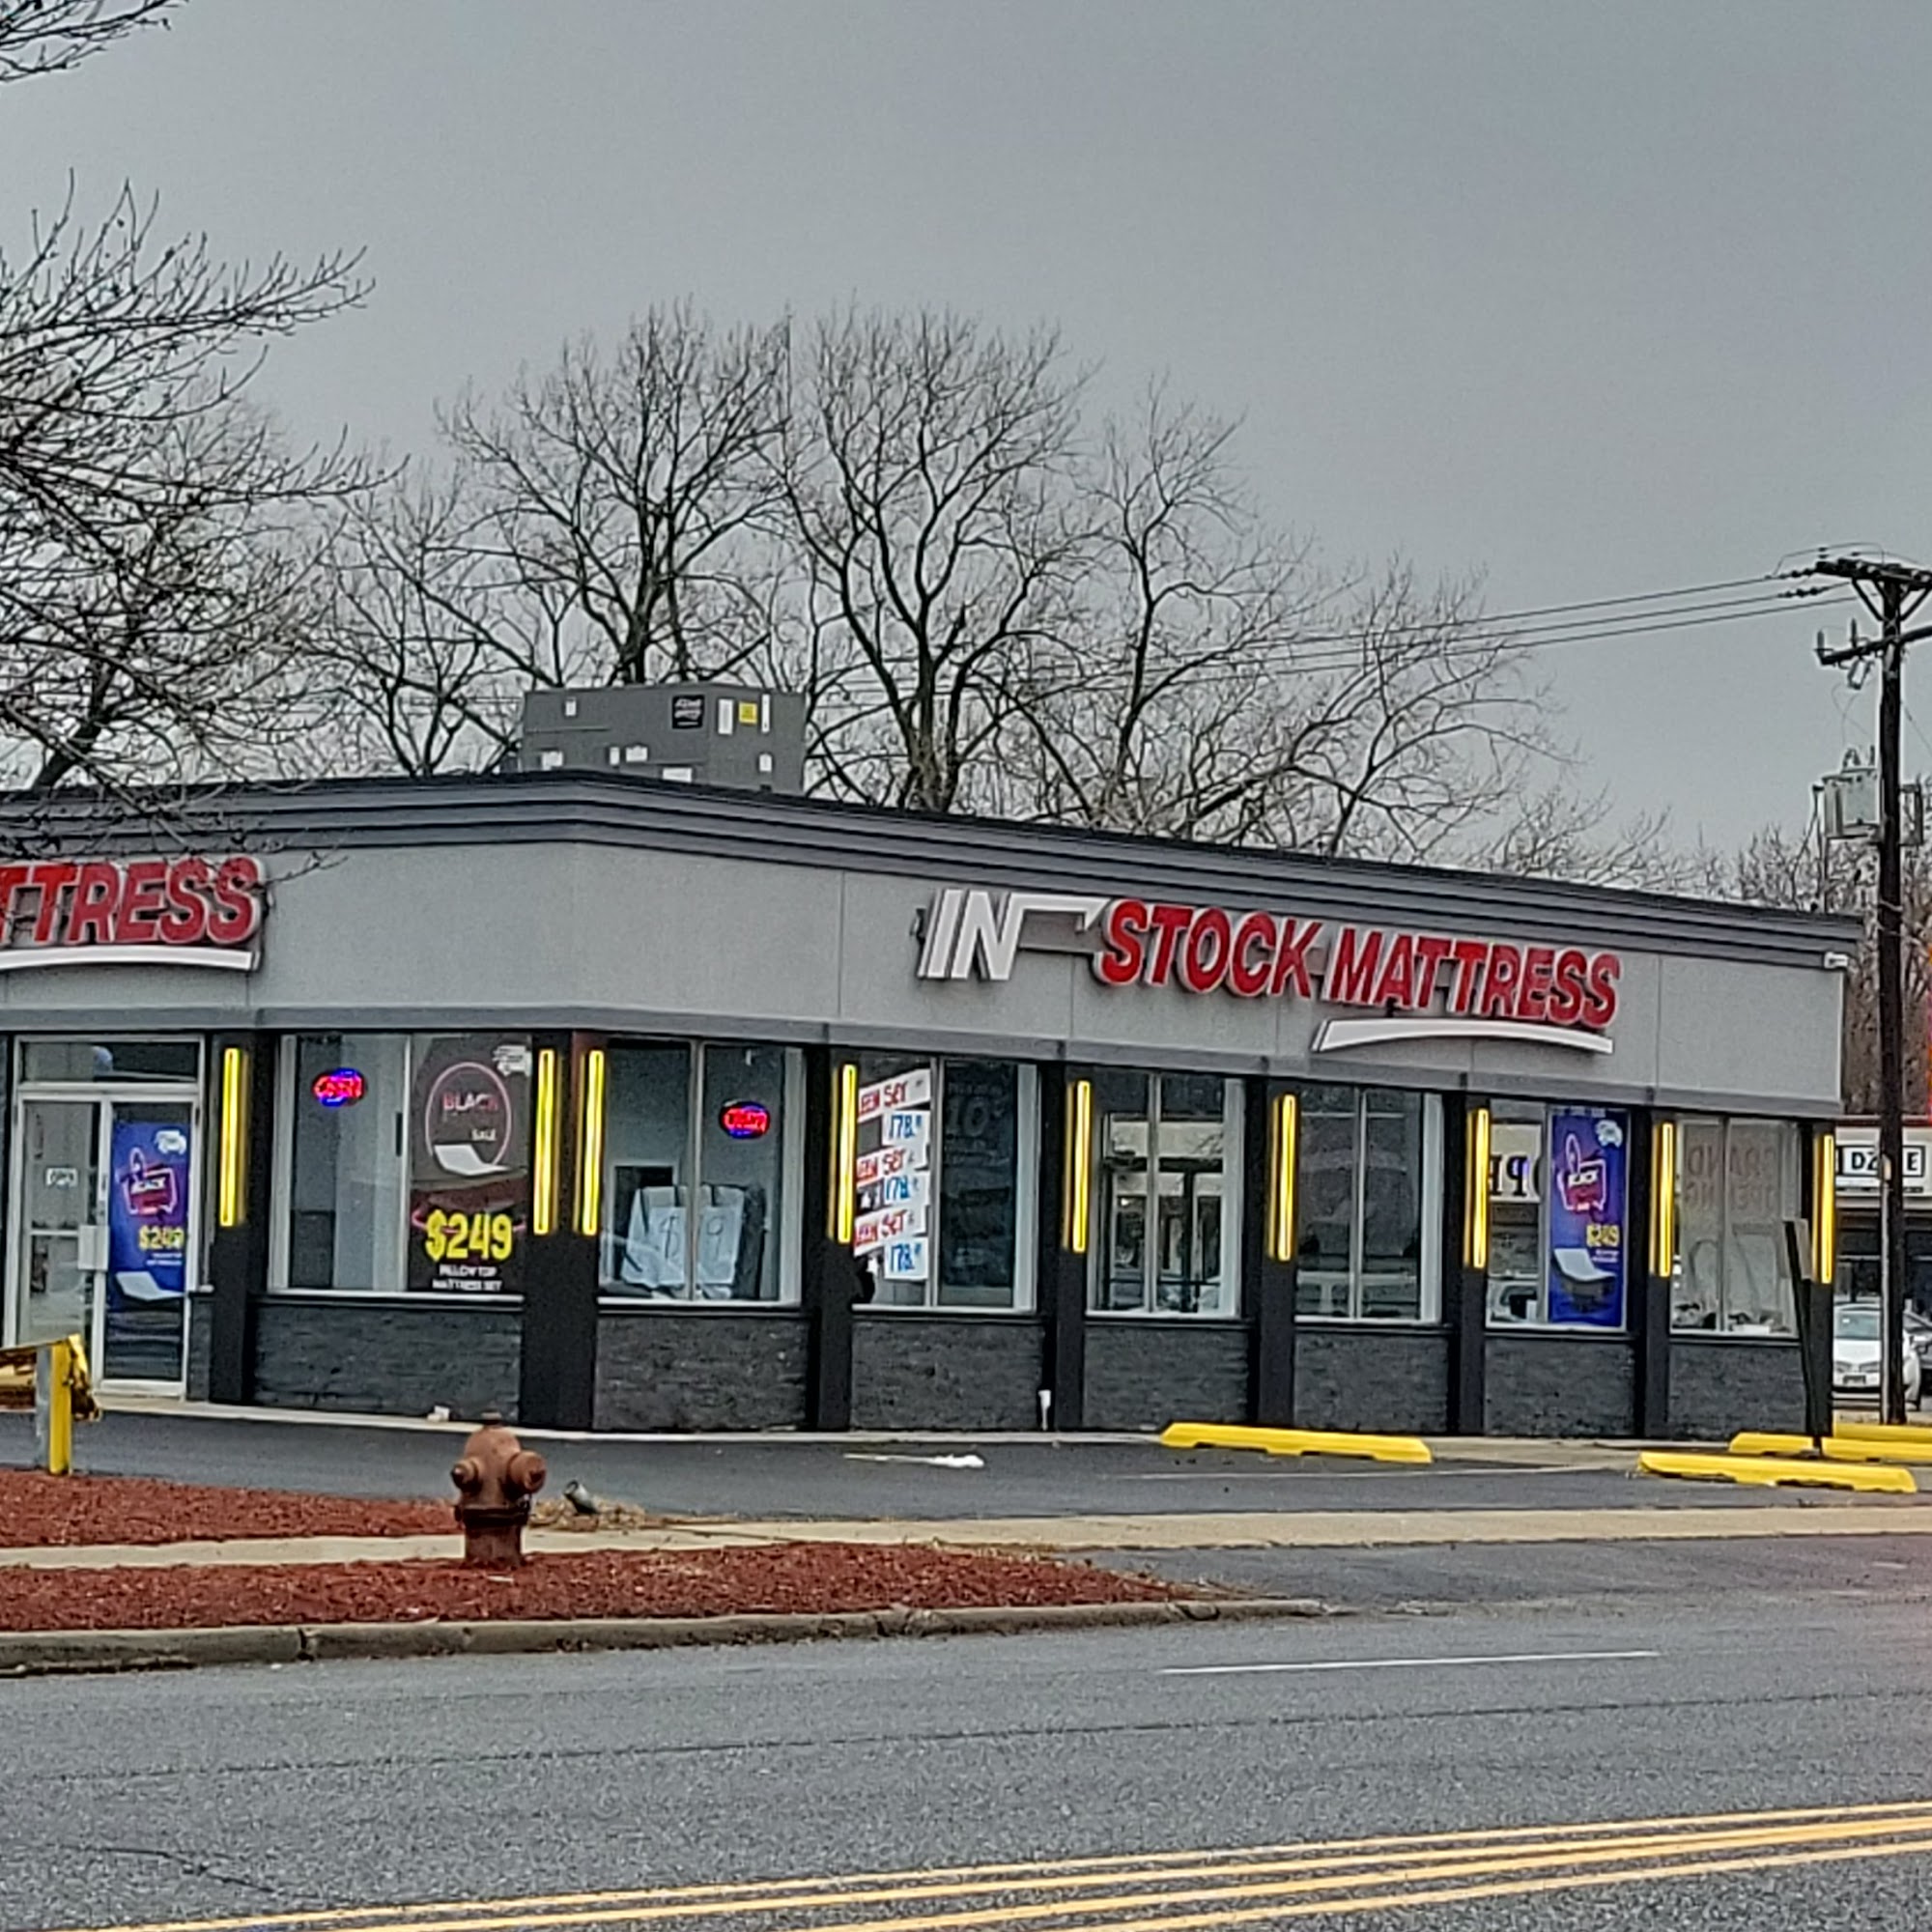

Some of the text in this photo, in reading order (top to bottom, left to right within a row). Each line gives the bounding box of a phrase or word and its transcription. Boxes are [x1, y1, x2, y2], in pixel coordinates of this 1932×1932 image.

[0, 855, 263, 944] TTRESS
[918, 889, 1621, 1029] IN STOCK MATTRESS
[425, 1208, 513, 1262] $249
